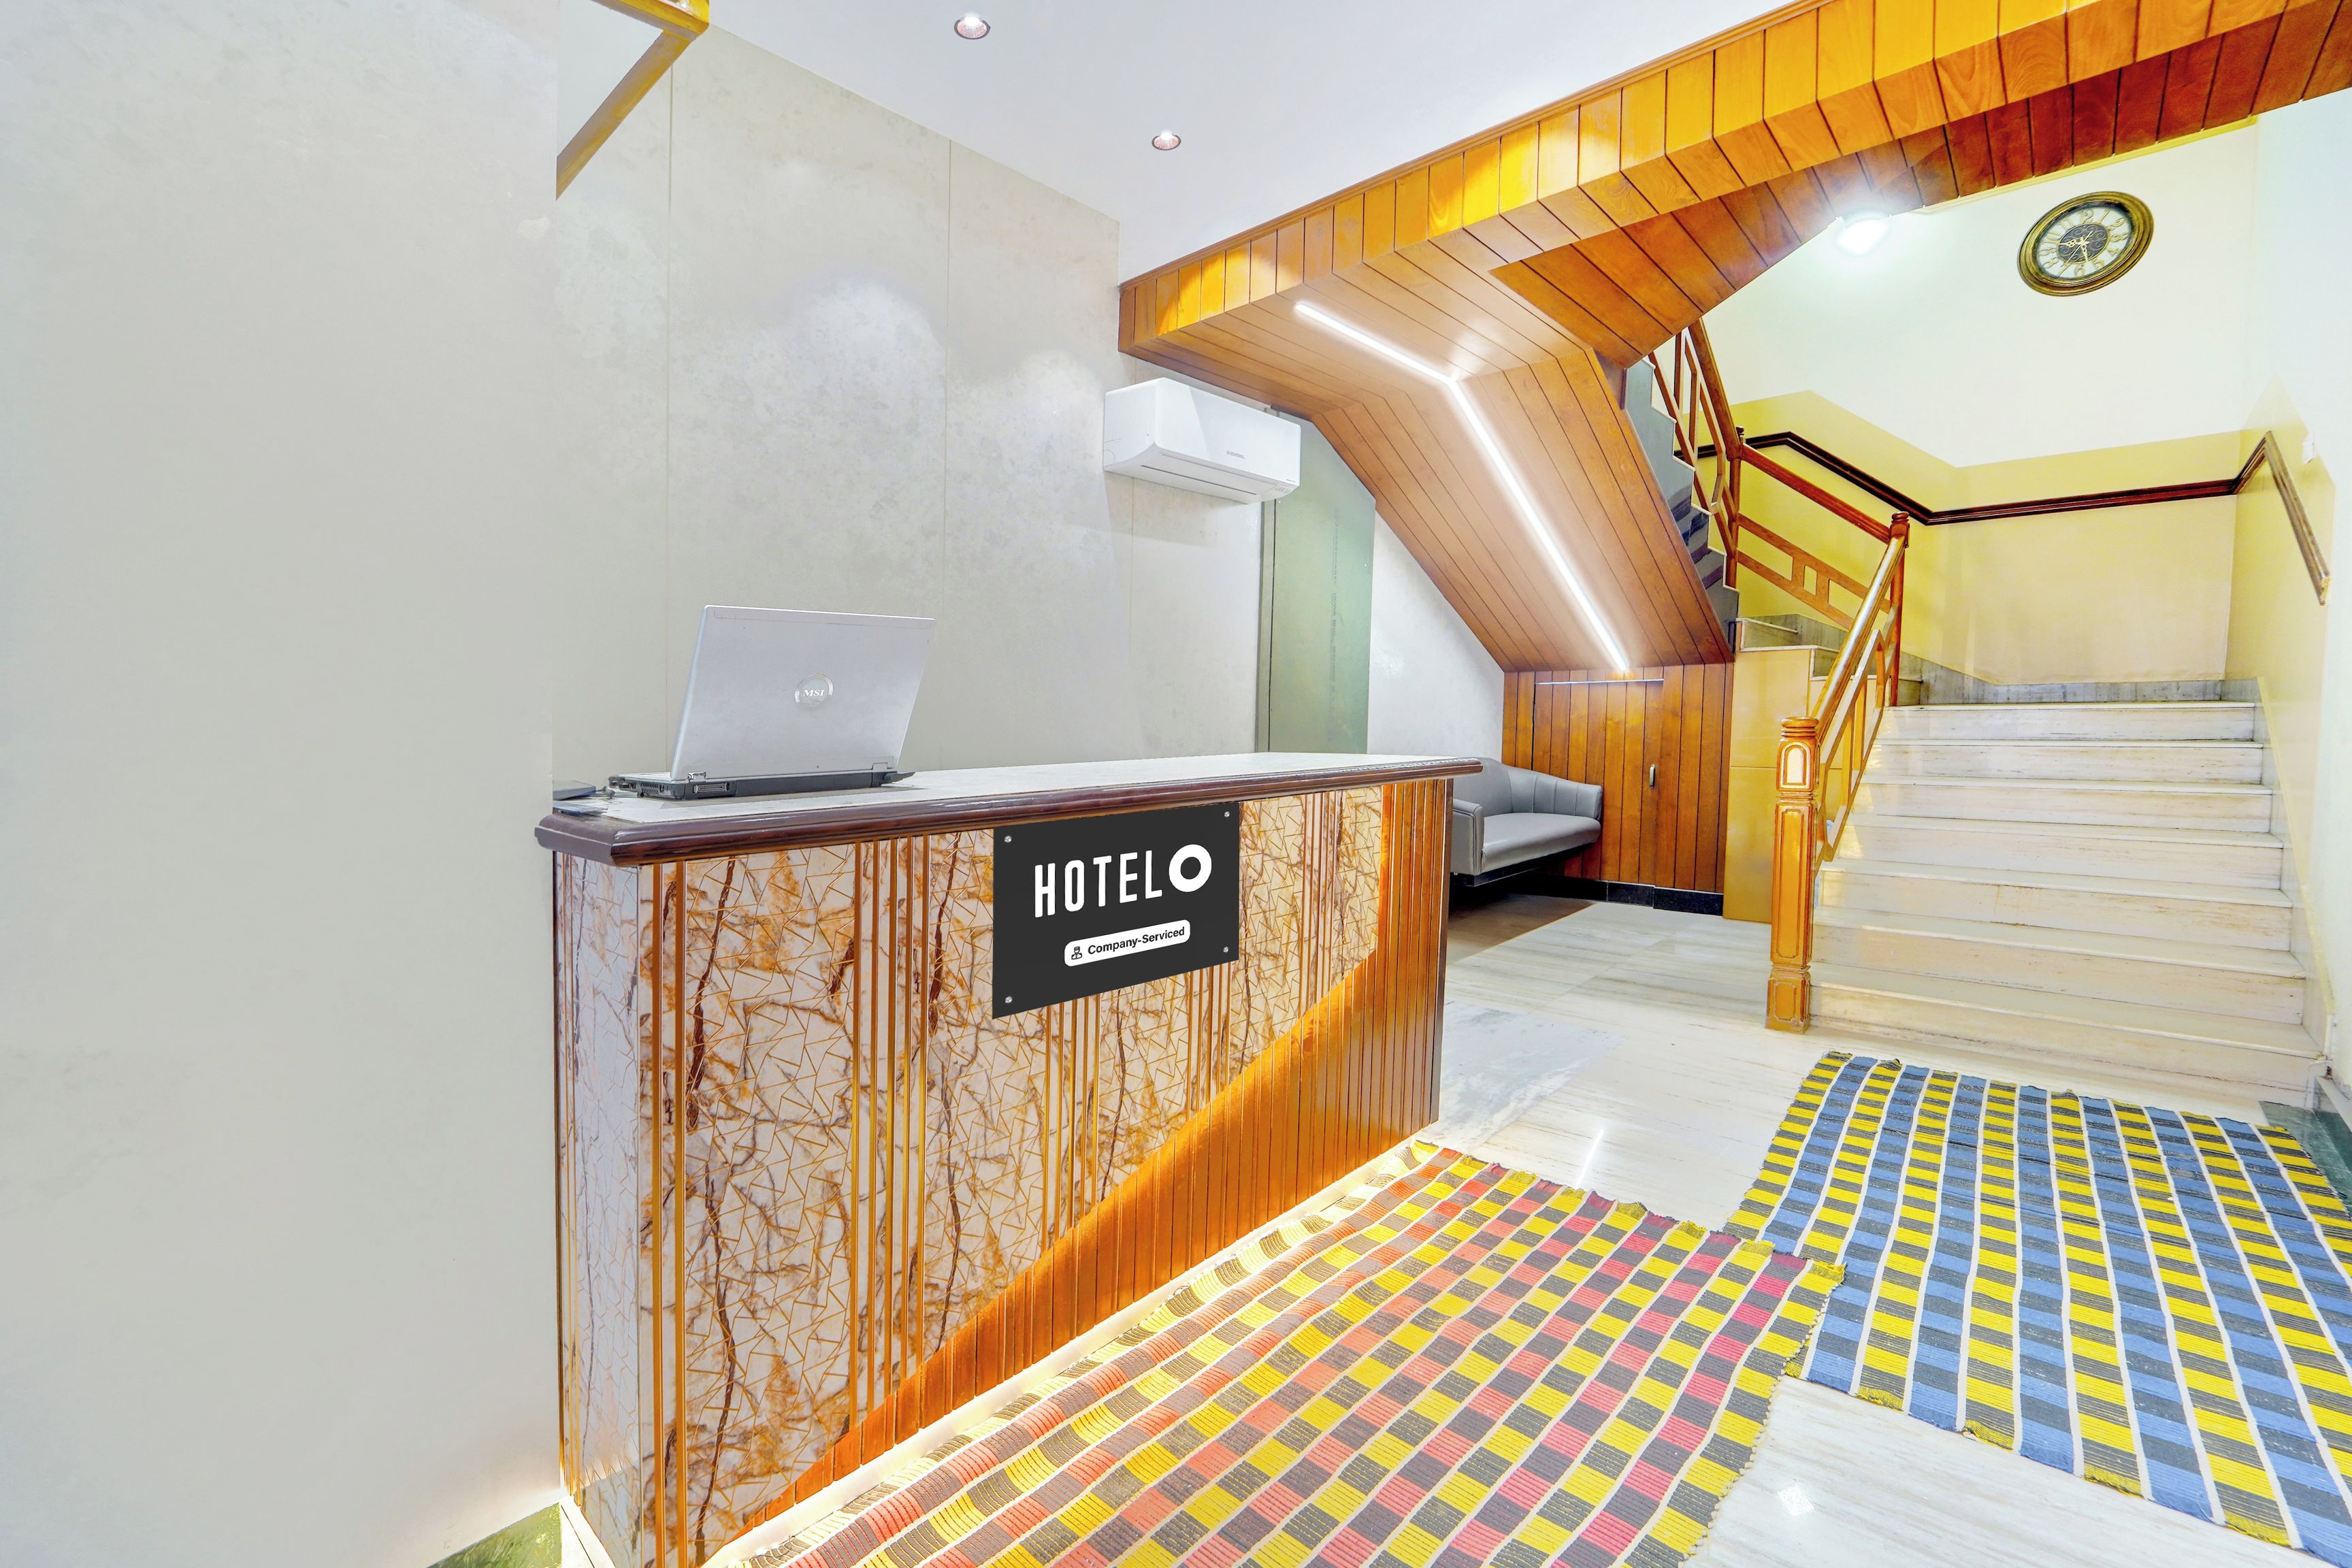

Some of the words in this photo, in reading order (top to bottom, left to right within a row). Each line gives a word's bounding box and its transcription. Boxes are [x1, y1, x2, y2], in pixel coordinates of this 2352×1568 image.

[2078, 210, 2093, 224] 12
[1034, 850, 1162, 918] HOTEL
[1088, 926, 1185, 955] Company-Serviced
